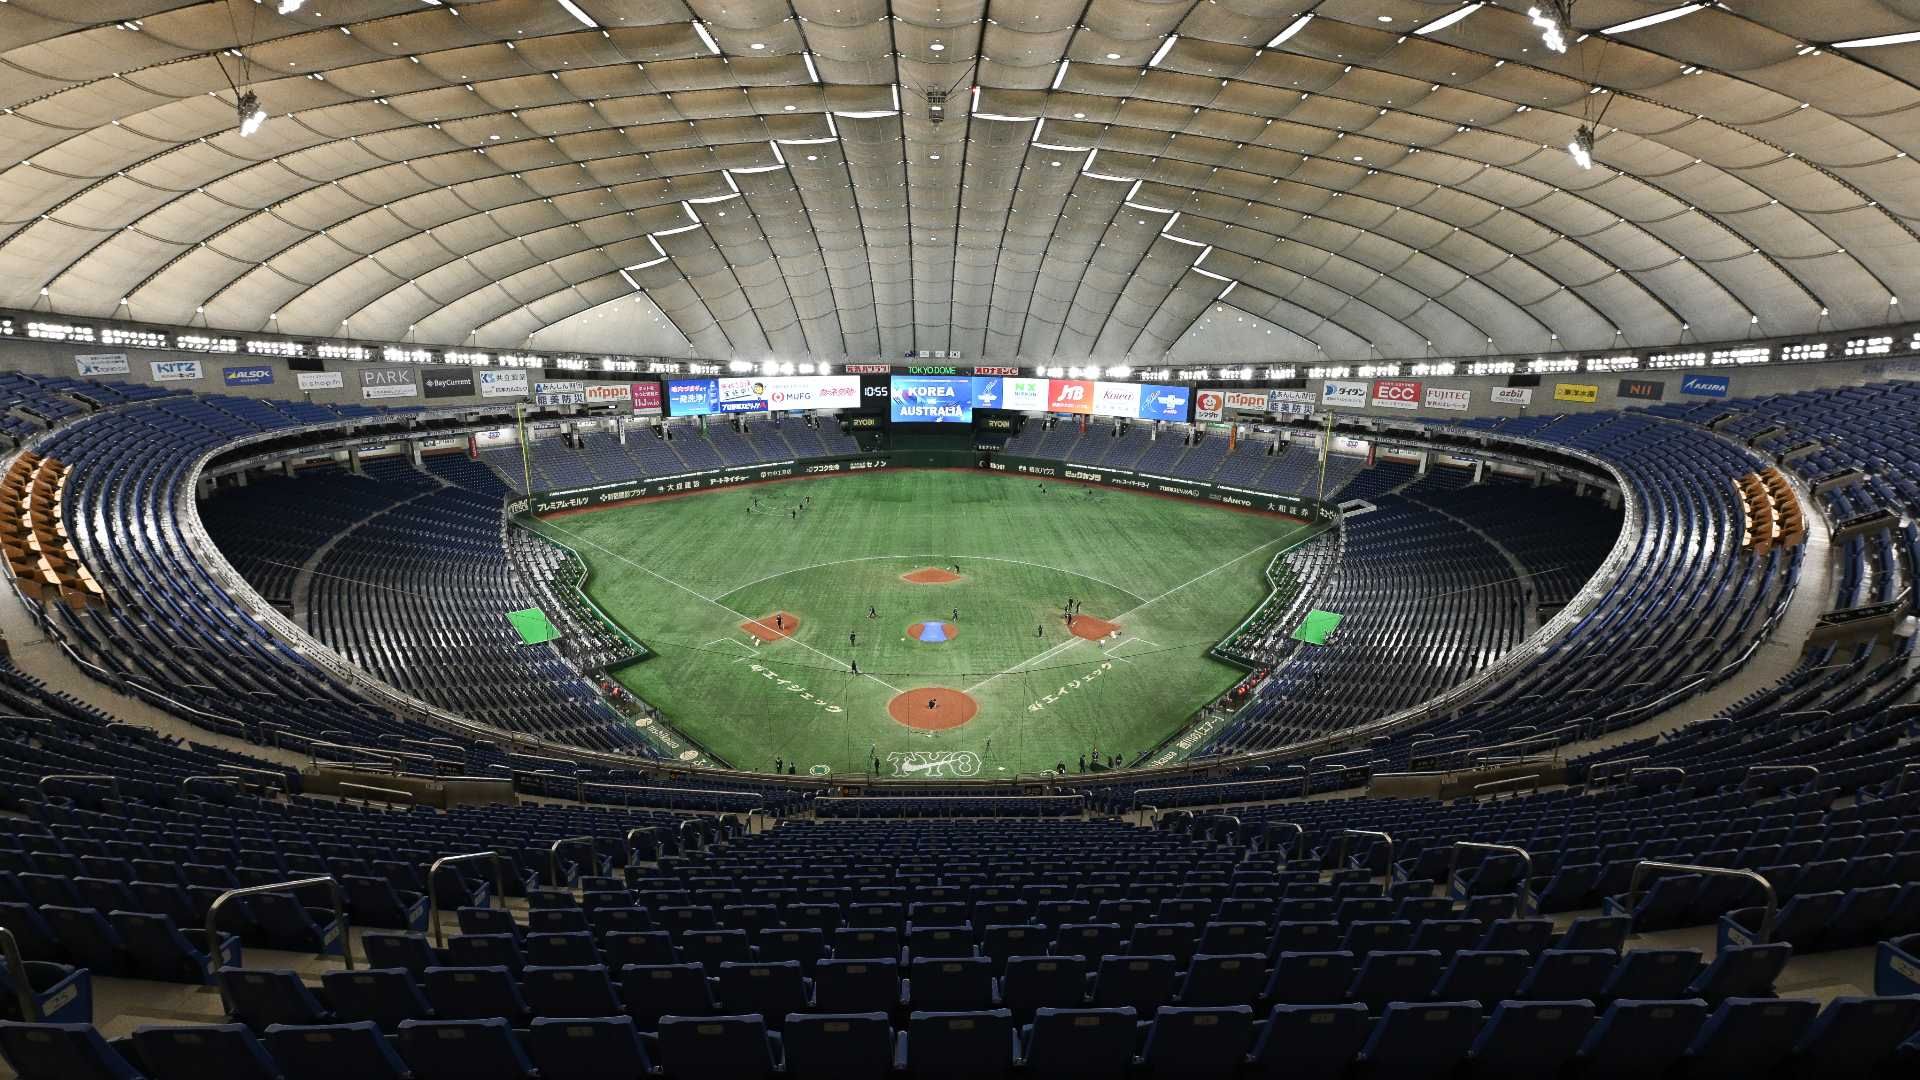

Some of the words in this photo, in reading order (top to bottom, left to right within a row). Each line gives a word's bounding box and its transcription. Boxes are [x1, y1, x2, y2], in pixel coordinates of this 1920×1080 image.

[157, 362, 196, 373] KITZ
[365, 370, 409, 384] PARK
[434, 379, 471, 388] BayCurrent
[786, 392, 811, 400] MUFG
[864, 386, 888, 397] 10:55
[909, 386, 954, 396] KOREA
[1378, 386, 1414, 400] ECC
[1428, 389, 1469, 400] FUJITEC
[1500, 389, 1523, 398] azbil
[900, 405, 963, 416] AUSTRALIA
[988, 420, 1010, 428] RYOBI
[1223, 495, 1252, 506] SANKYO
